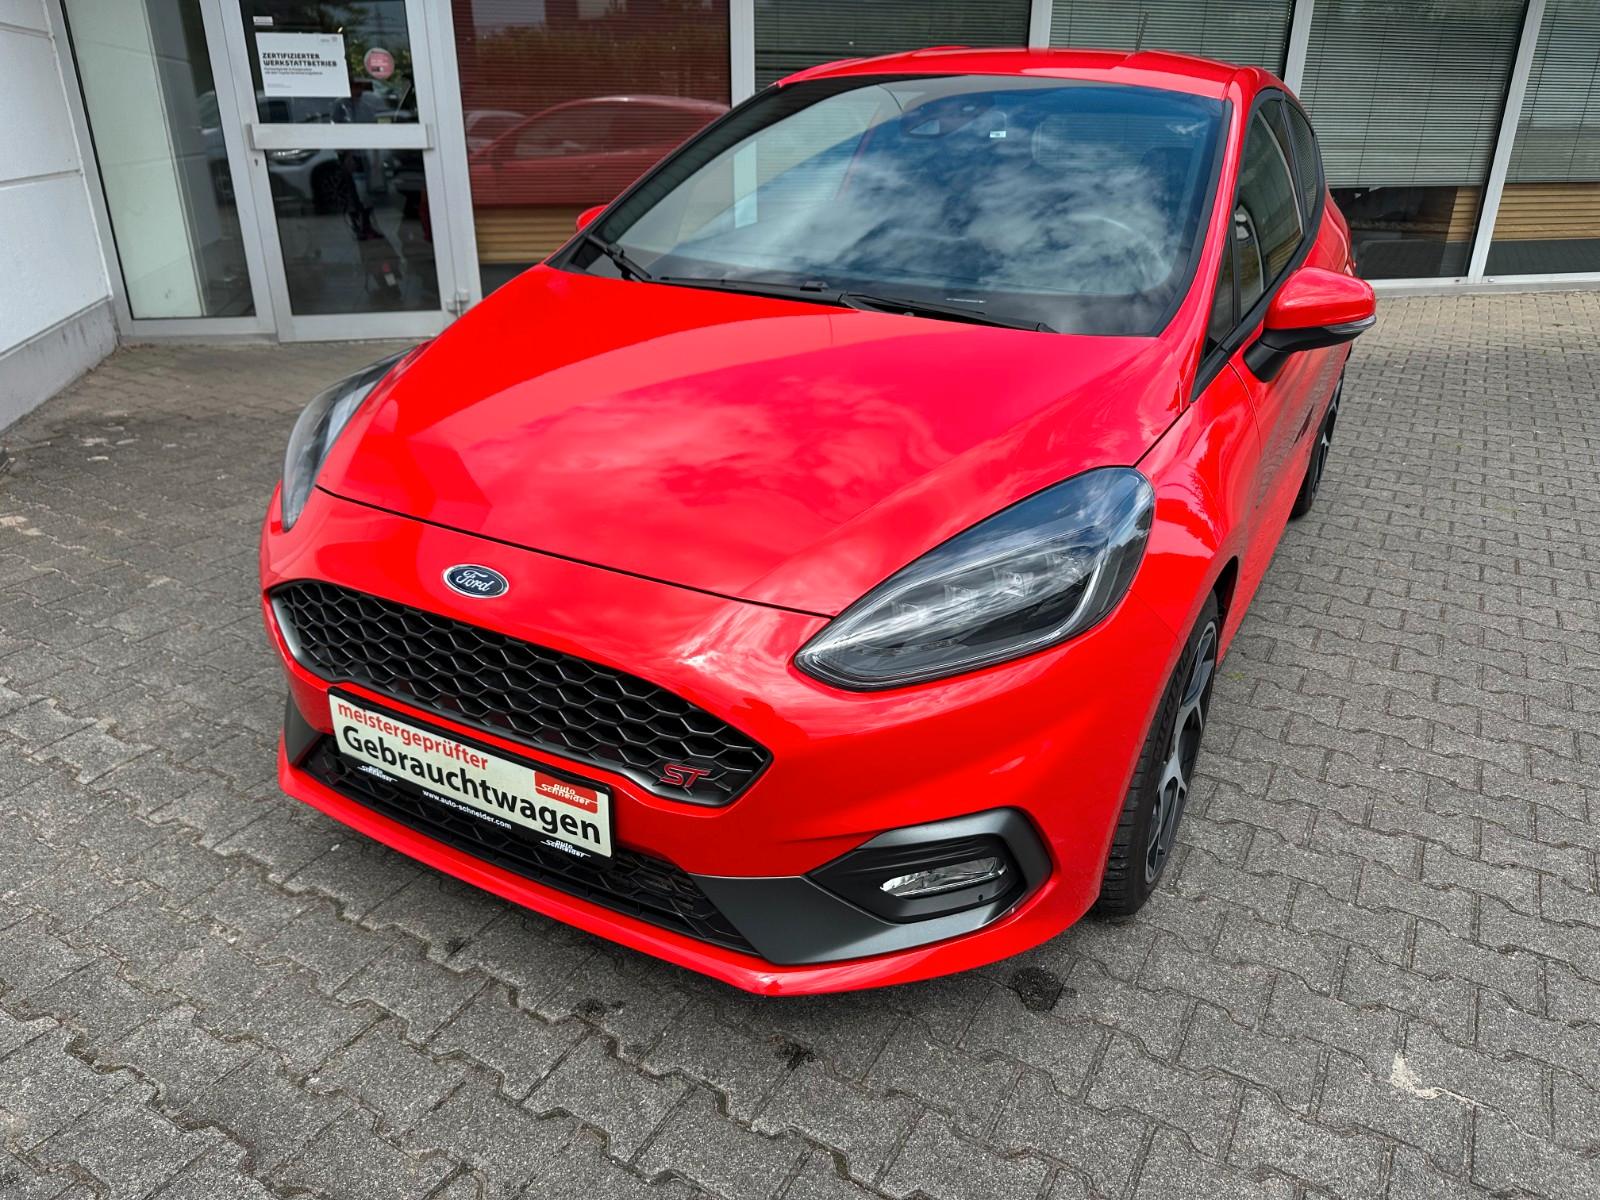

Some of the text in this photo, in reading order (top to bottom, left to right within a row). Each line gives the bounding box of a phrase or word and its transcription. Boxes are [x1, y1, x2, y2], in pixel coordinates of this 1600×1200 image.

[456, 569, 495, 592] Ford
[337, 702, 488, 770] meistergeprüfter
[342, 725, 601, 845] Gebrauchtwagen
[553, 783, 576, 796] auto
[660, 763, 712, 788] ST
[422, 790, 512, 830] www.auto-schneider.com
